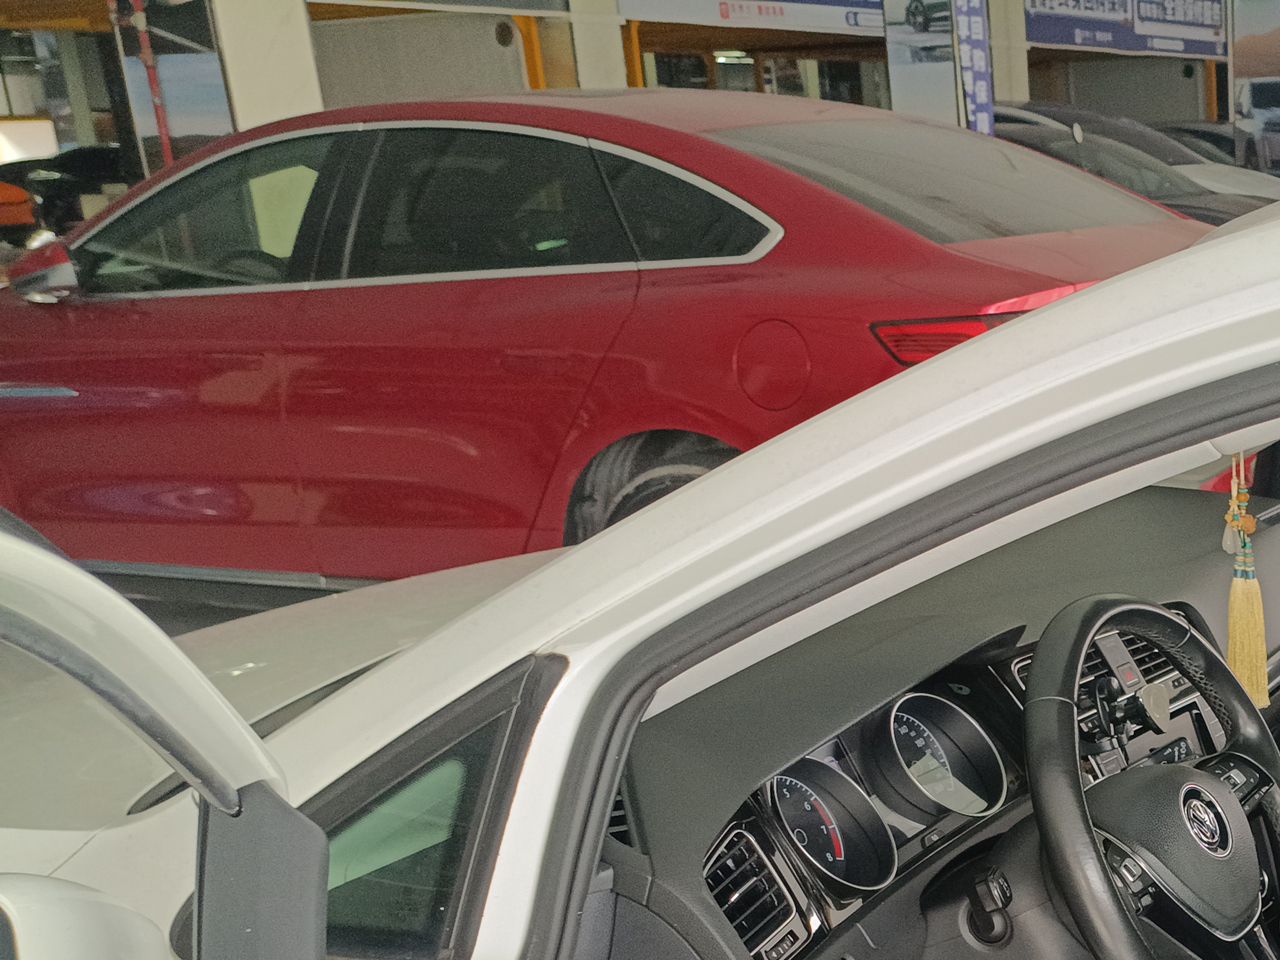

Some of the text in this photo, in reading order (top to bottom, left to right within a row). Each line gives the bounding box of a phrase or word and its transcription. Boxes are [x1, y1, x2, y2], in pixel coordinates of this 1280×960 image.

[783, 788, 791, 799] 5
[804, 801, 812, 812] 6
[820, 825, 828, 835] 7
[826, 852, 834, 863] 8
